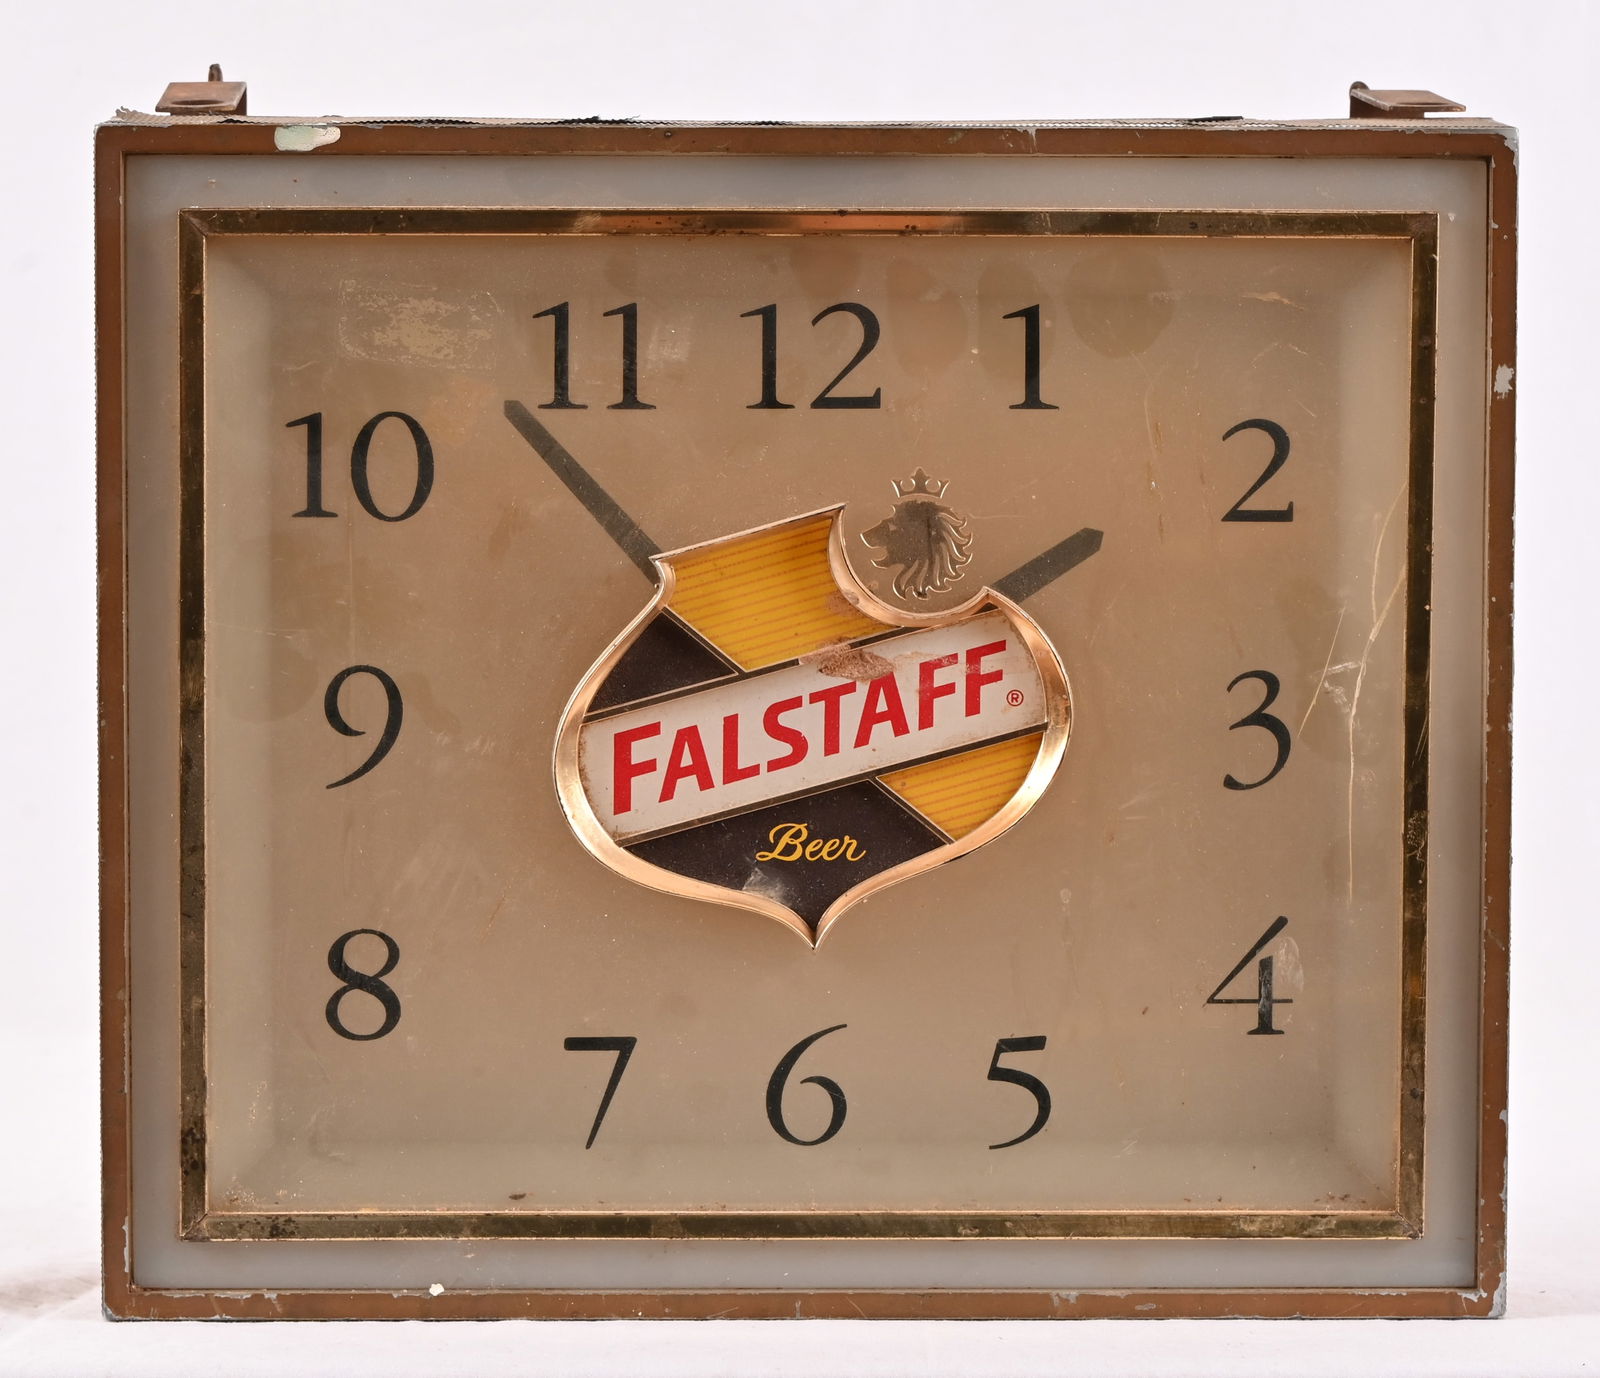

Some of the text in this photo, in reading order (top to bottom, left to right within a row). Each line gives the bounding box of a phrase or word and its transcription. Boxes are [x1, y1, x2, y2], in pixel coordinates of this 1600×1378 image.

[532, 302, 656, 409] 11
[740, 302, 881, 409] 12
[1002, 304, 1059, 409] 1
[285, 411, 434, 522] 10
[1221, 419, 1293, 522] 2
[324, 665, 403, 789] 9
[1223, 670, 1291, 790] 3
[755, 823, 866, 863] Beer
[325, 929, 401, 1041] 8
[1207, 916, 1293, 1035] 4
[564, 1037, 637, 1149] 7
[766, 1024, 847, 1146] 6
[987, 1036, 1051, 1149] 5
